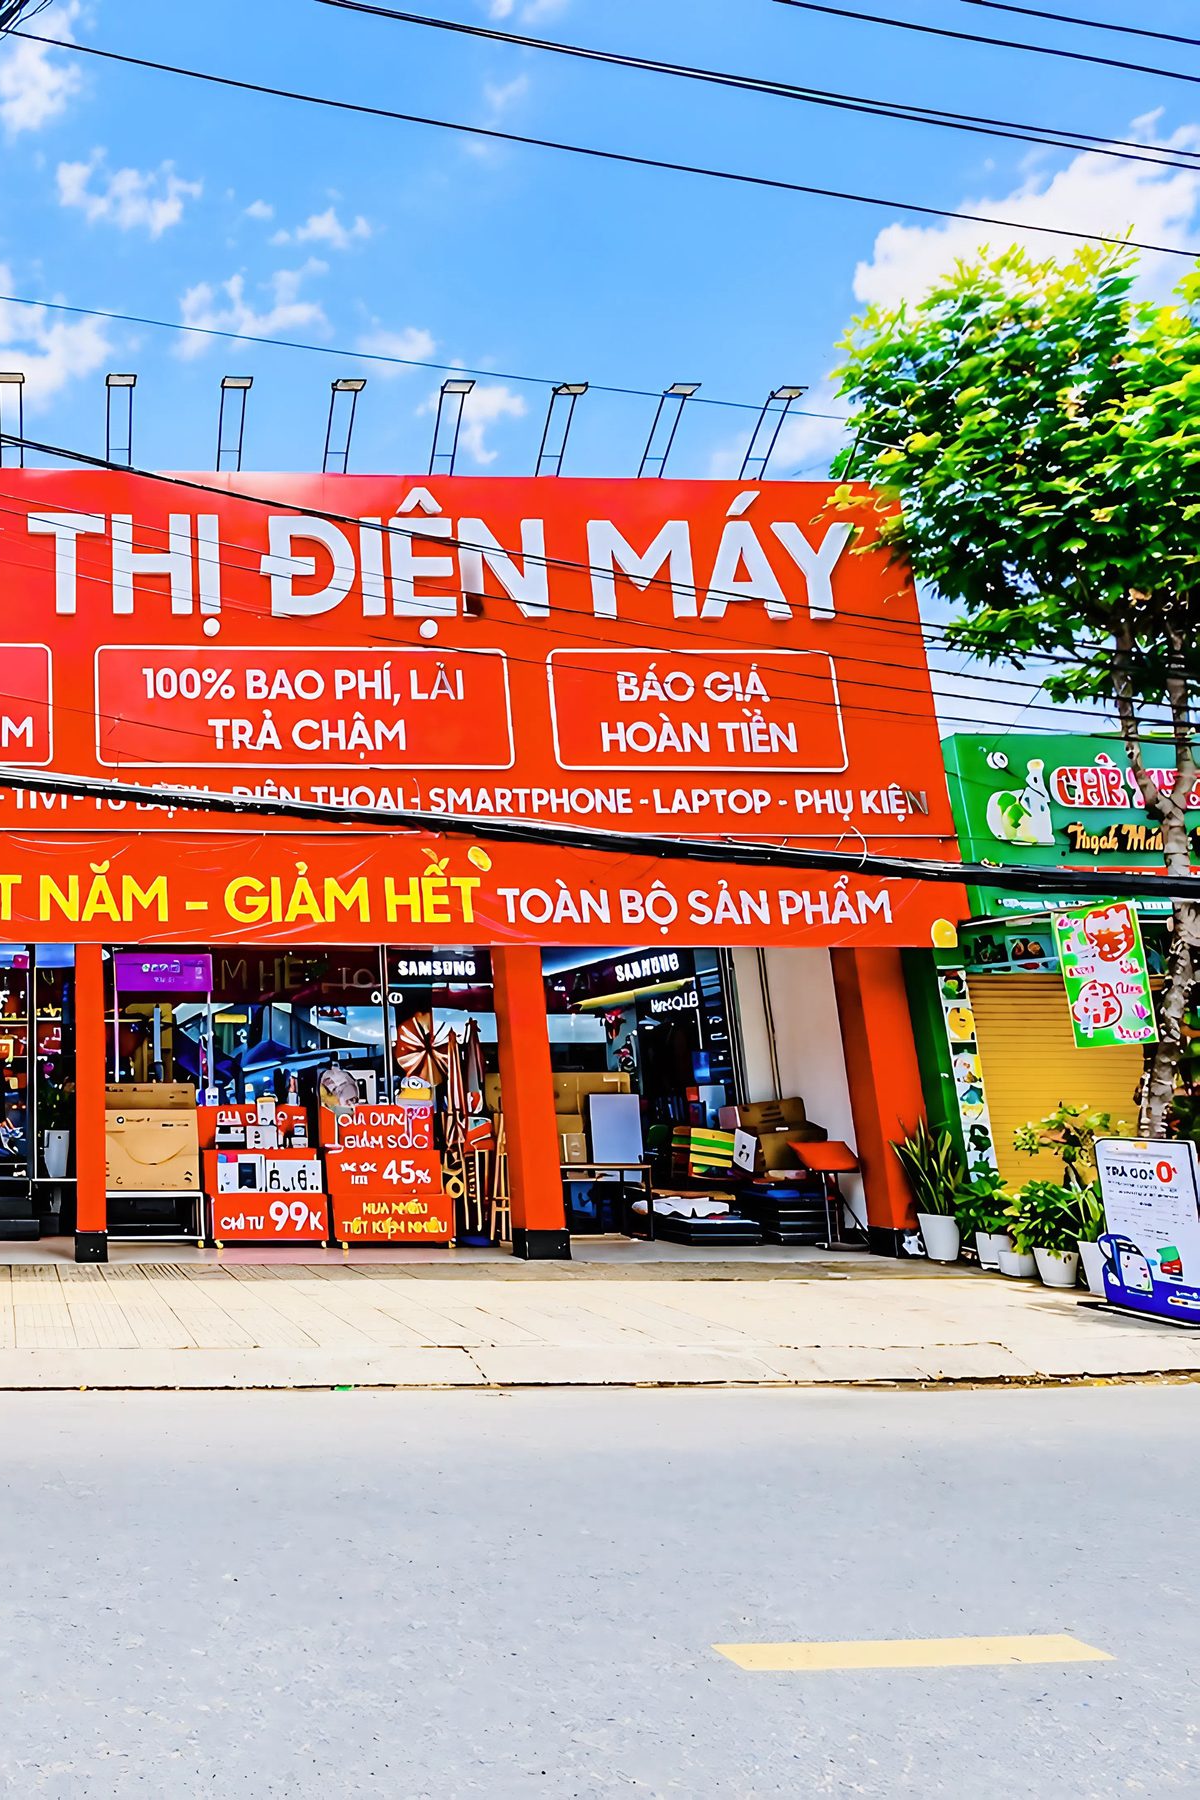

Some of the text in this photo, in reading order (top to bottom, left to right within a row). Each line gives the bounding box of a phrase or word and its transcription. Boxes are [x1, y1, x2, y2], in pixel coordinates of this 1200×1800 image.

[27, 513, 222, 637] THỊ
[259, 487, 552, 639] ĐIỆN
[586, 491, 854, 620] MÁY
[142, 667, 235, 700] 100%
[246, 669, 325, 700] BAO
[335, 661, 401, 706] PHÍ,
[616, 662, 695, 702] BÁO
[207, 709, 406, 760] TRẢ CHẬM
[600, 712, 710, 753] HOÀN
[430, 787, 634, 814] SMARTPHONE
[652, 788, 772, 814] LAPTOP
[794, 789, 854, 822] PHỤ
[860, 782, 930, 822] KIỆN
[40, 860, 169, 922] NĂM
[185, 901, 209, 911] -
[224, 861, 371, 923] GIẢM
[384, 855, 481, 923] HẾT
[496, 878, 611, 924] TOÀN
[619, 879, 678, 935] BỘ
[688, 879, 771, 925] SẢN
[778, 874, 893, 925] PHẨM
[397, 960, 476, 976] SAMSUNG
